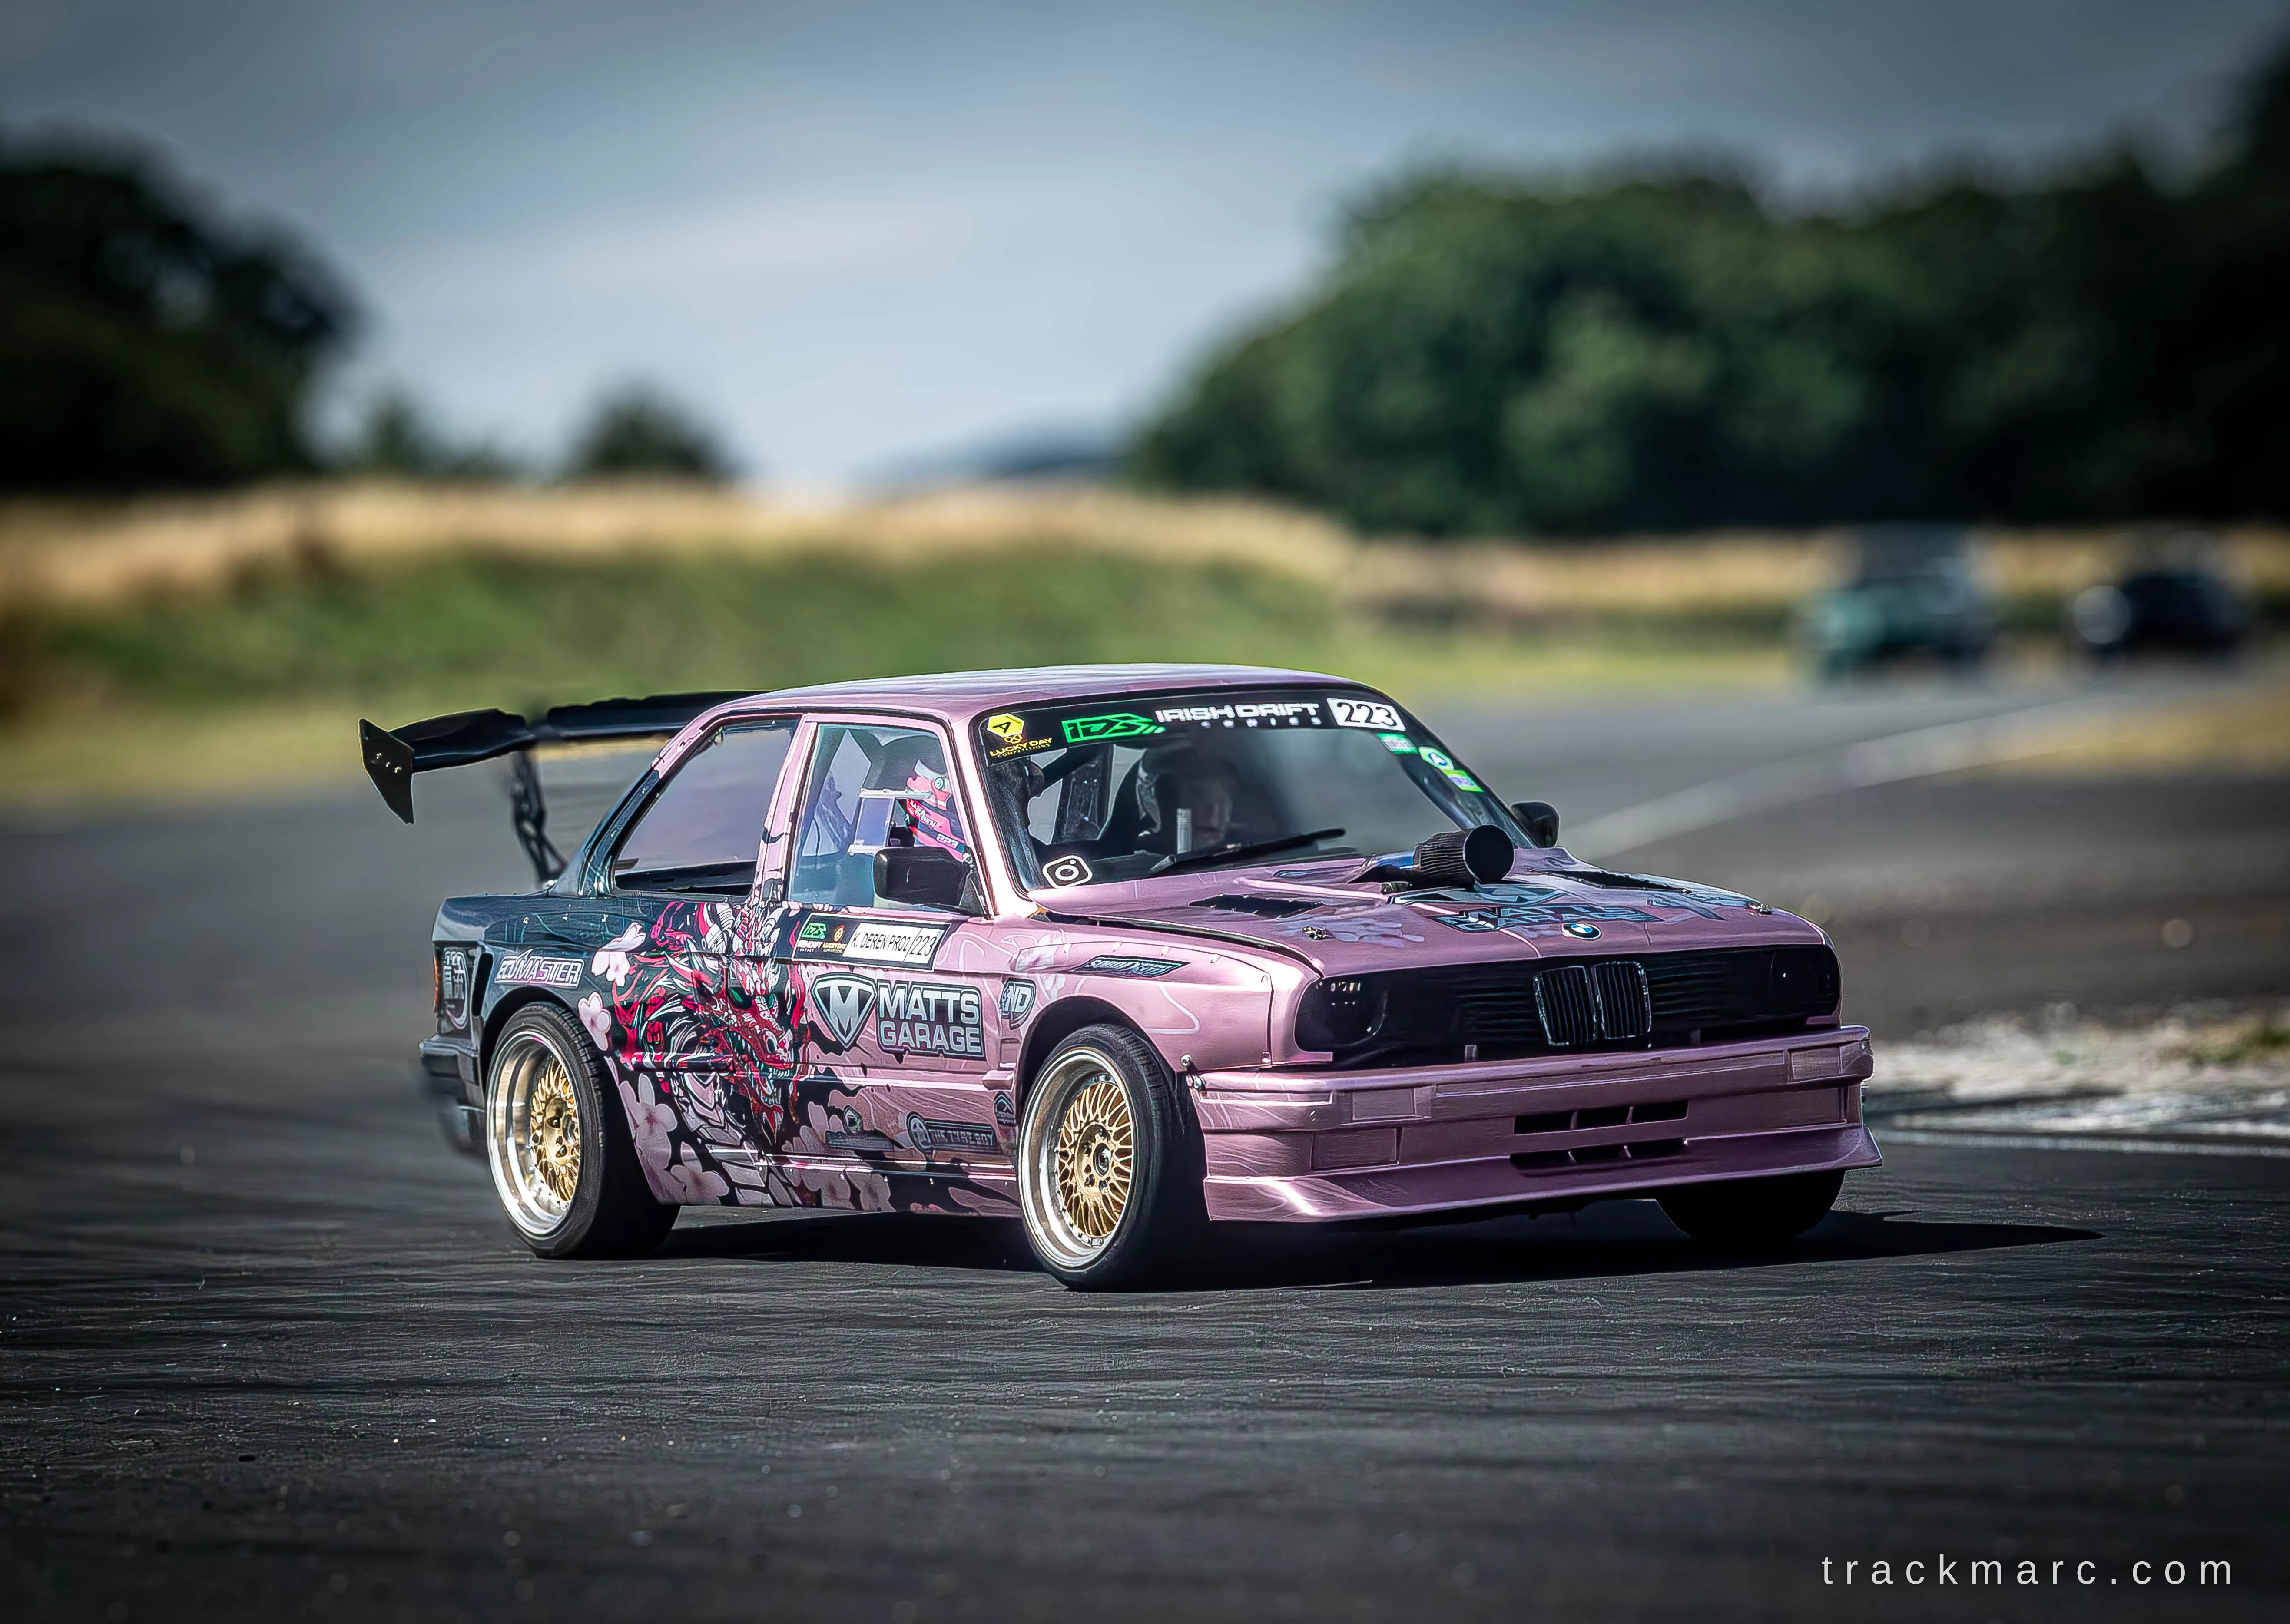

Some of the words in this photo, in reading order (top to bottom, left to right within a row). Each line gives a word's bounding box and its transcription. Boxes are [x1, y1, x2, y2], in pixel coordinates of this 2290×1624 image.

[1155, 705, 1235, 723] IRISH
[1234, 703, 1320, 718] DRIFT
[1336, 702, 1398, 727] 223
[989, 742, 1027, 757] LUCKY
[1029, 737, 1053, 747] DAY
[851, 932, 861, 948] K.
[860, 933, 890, 950] DEREN
[887, 935, 911, 952] PRO2
[909, 935, 938, 956] 223
[879, 986, 979, 1025] MATTS
[880, 1021, 981, 1052] GARAGE
